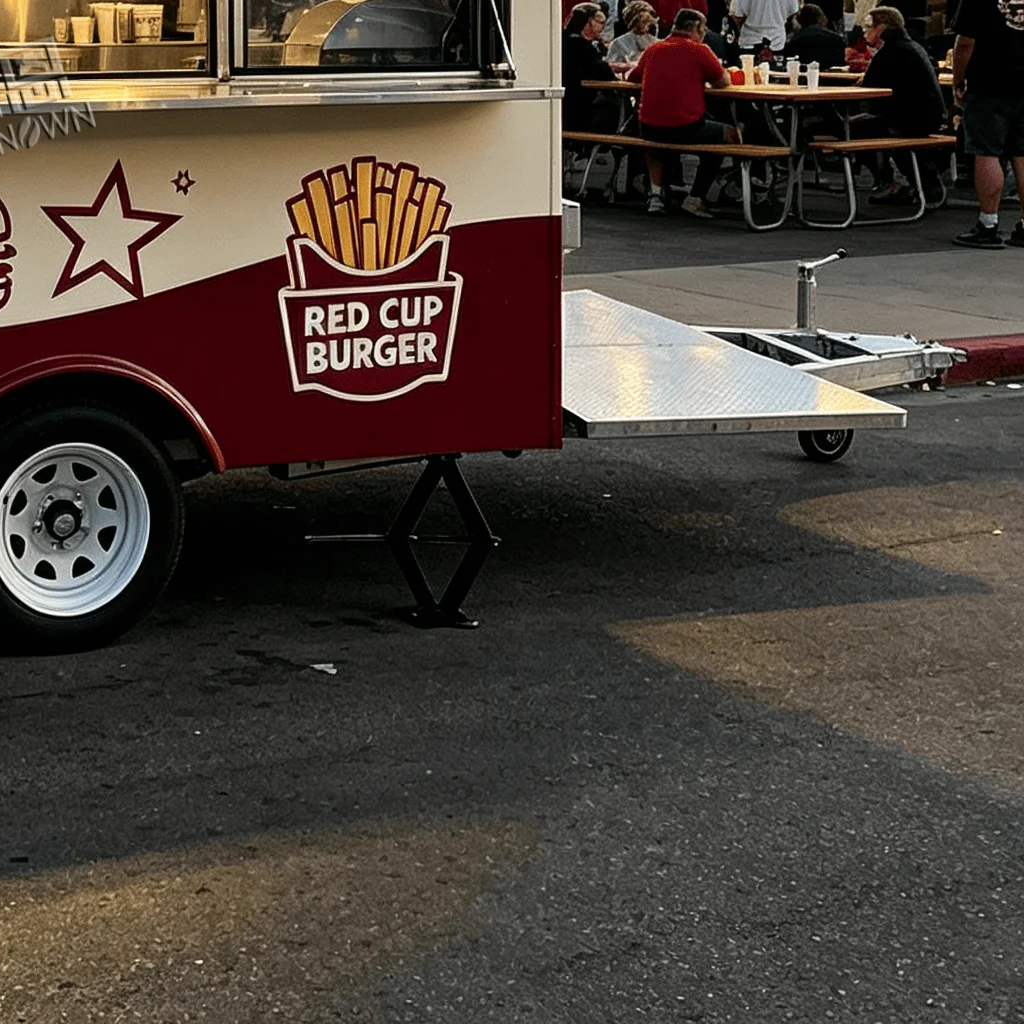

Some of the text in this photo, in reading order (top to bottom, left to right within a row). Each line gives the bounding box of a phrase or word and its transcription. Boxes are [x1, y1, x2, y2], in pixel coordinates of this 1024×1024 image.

[304, 295, 444, 336] RED CUP
[306, 331, 438, 374] BURGER
